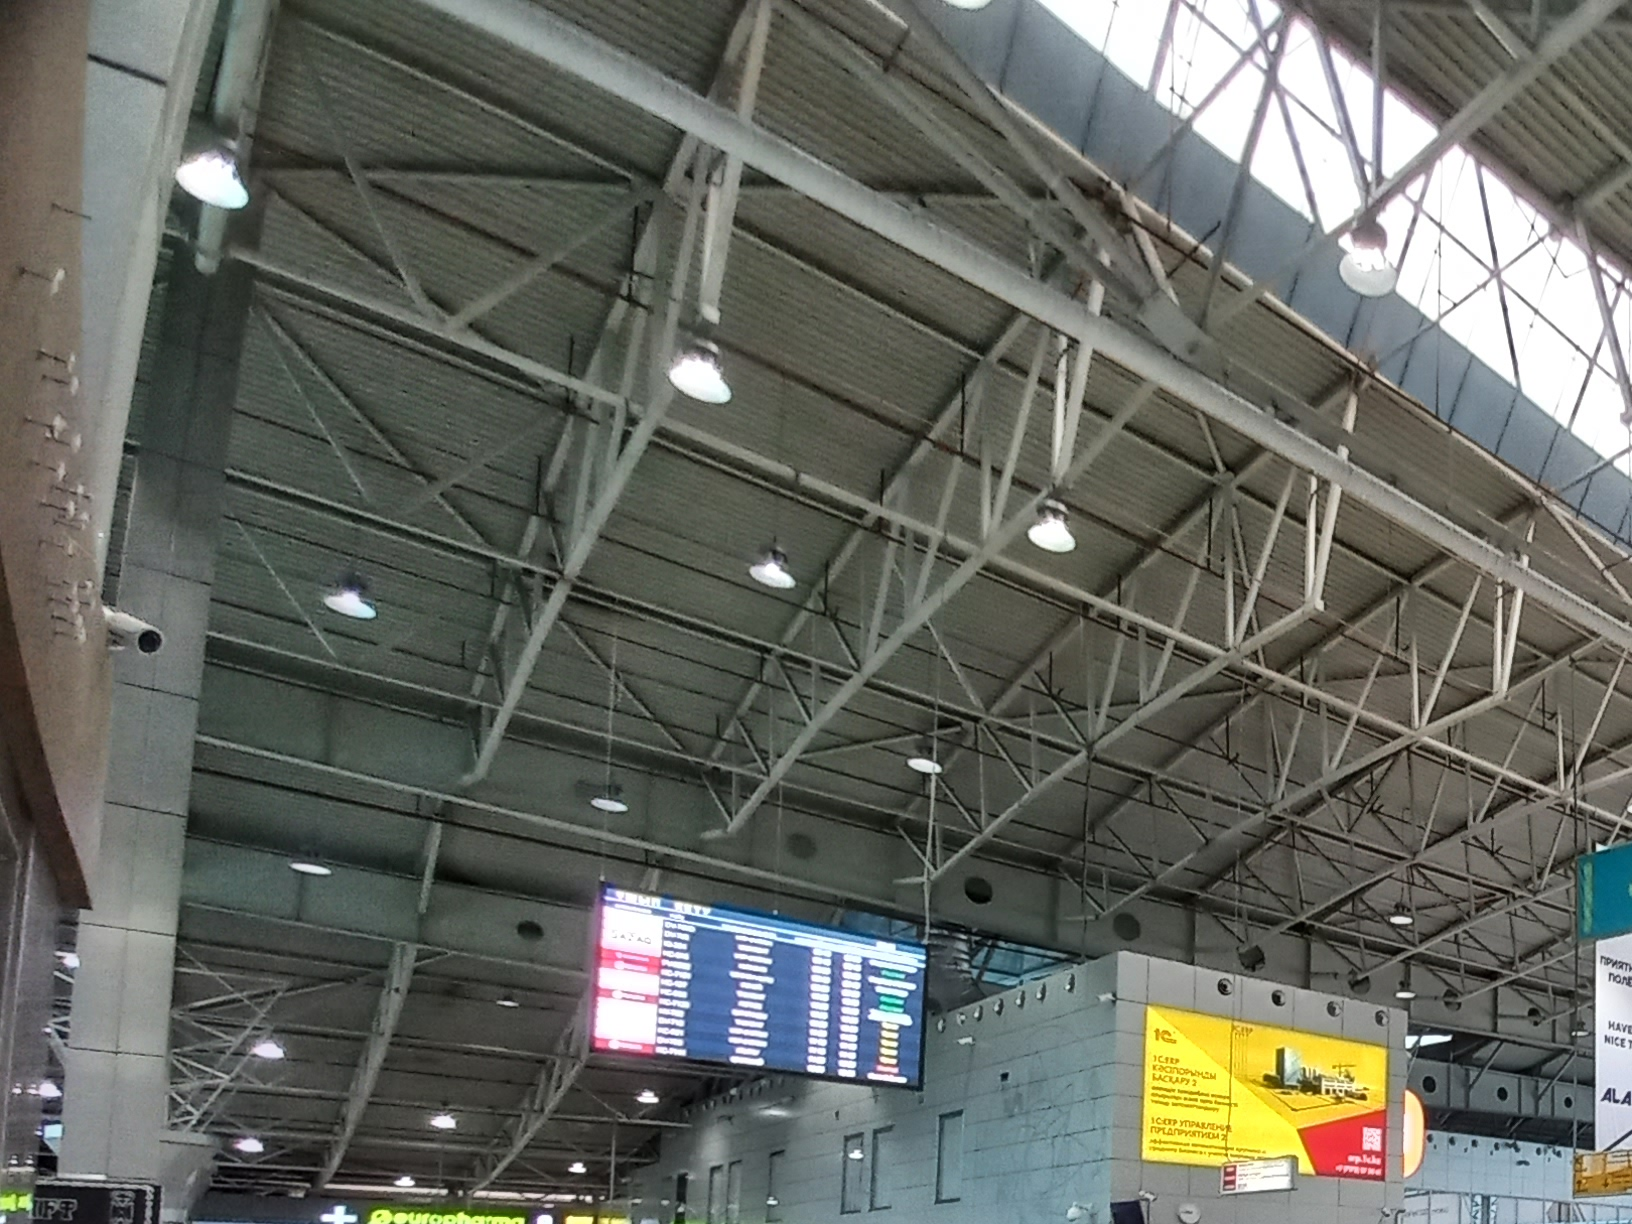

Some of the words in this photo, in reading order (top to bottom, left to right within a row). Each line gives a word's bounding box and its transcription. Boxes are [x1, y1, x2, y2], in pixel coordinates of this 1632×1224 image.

[1608, 1020, 1632, 1035] HAVE
[1604, 1035, 1626, 1048] NICE
[1600, 1087, 1632, 1106] ALA
